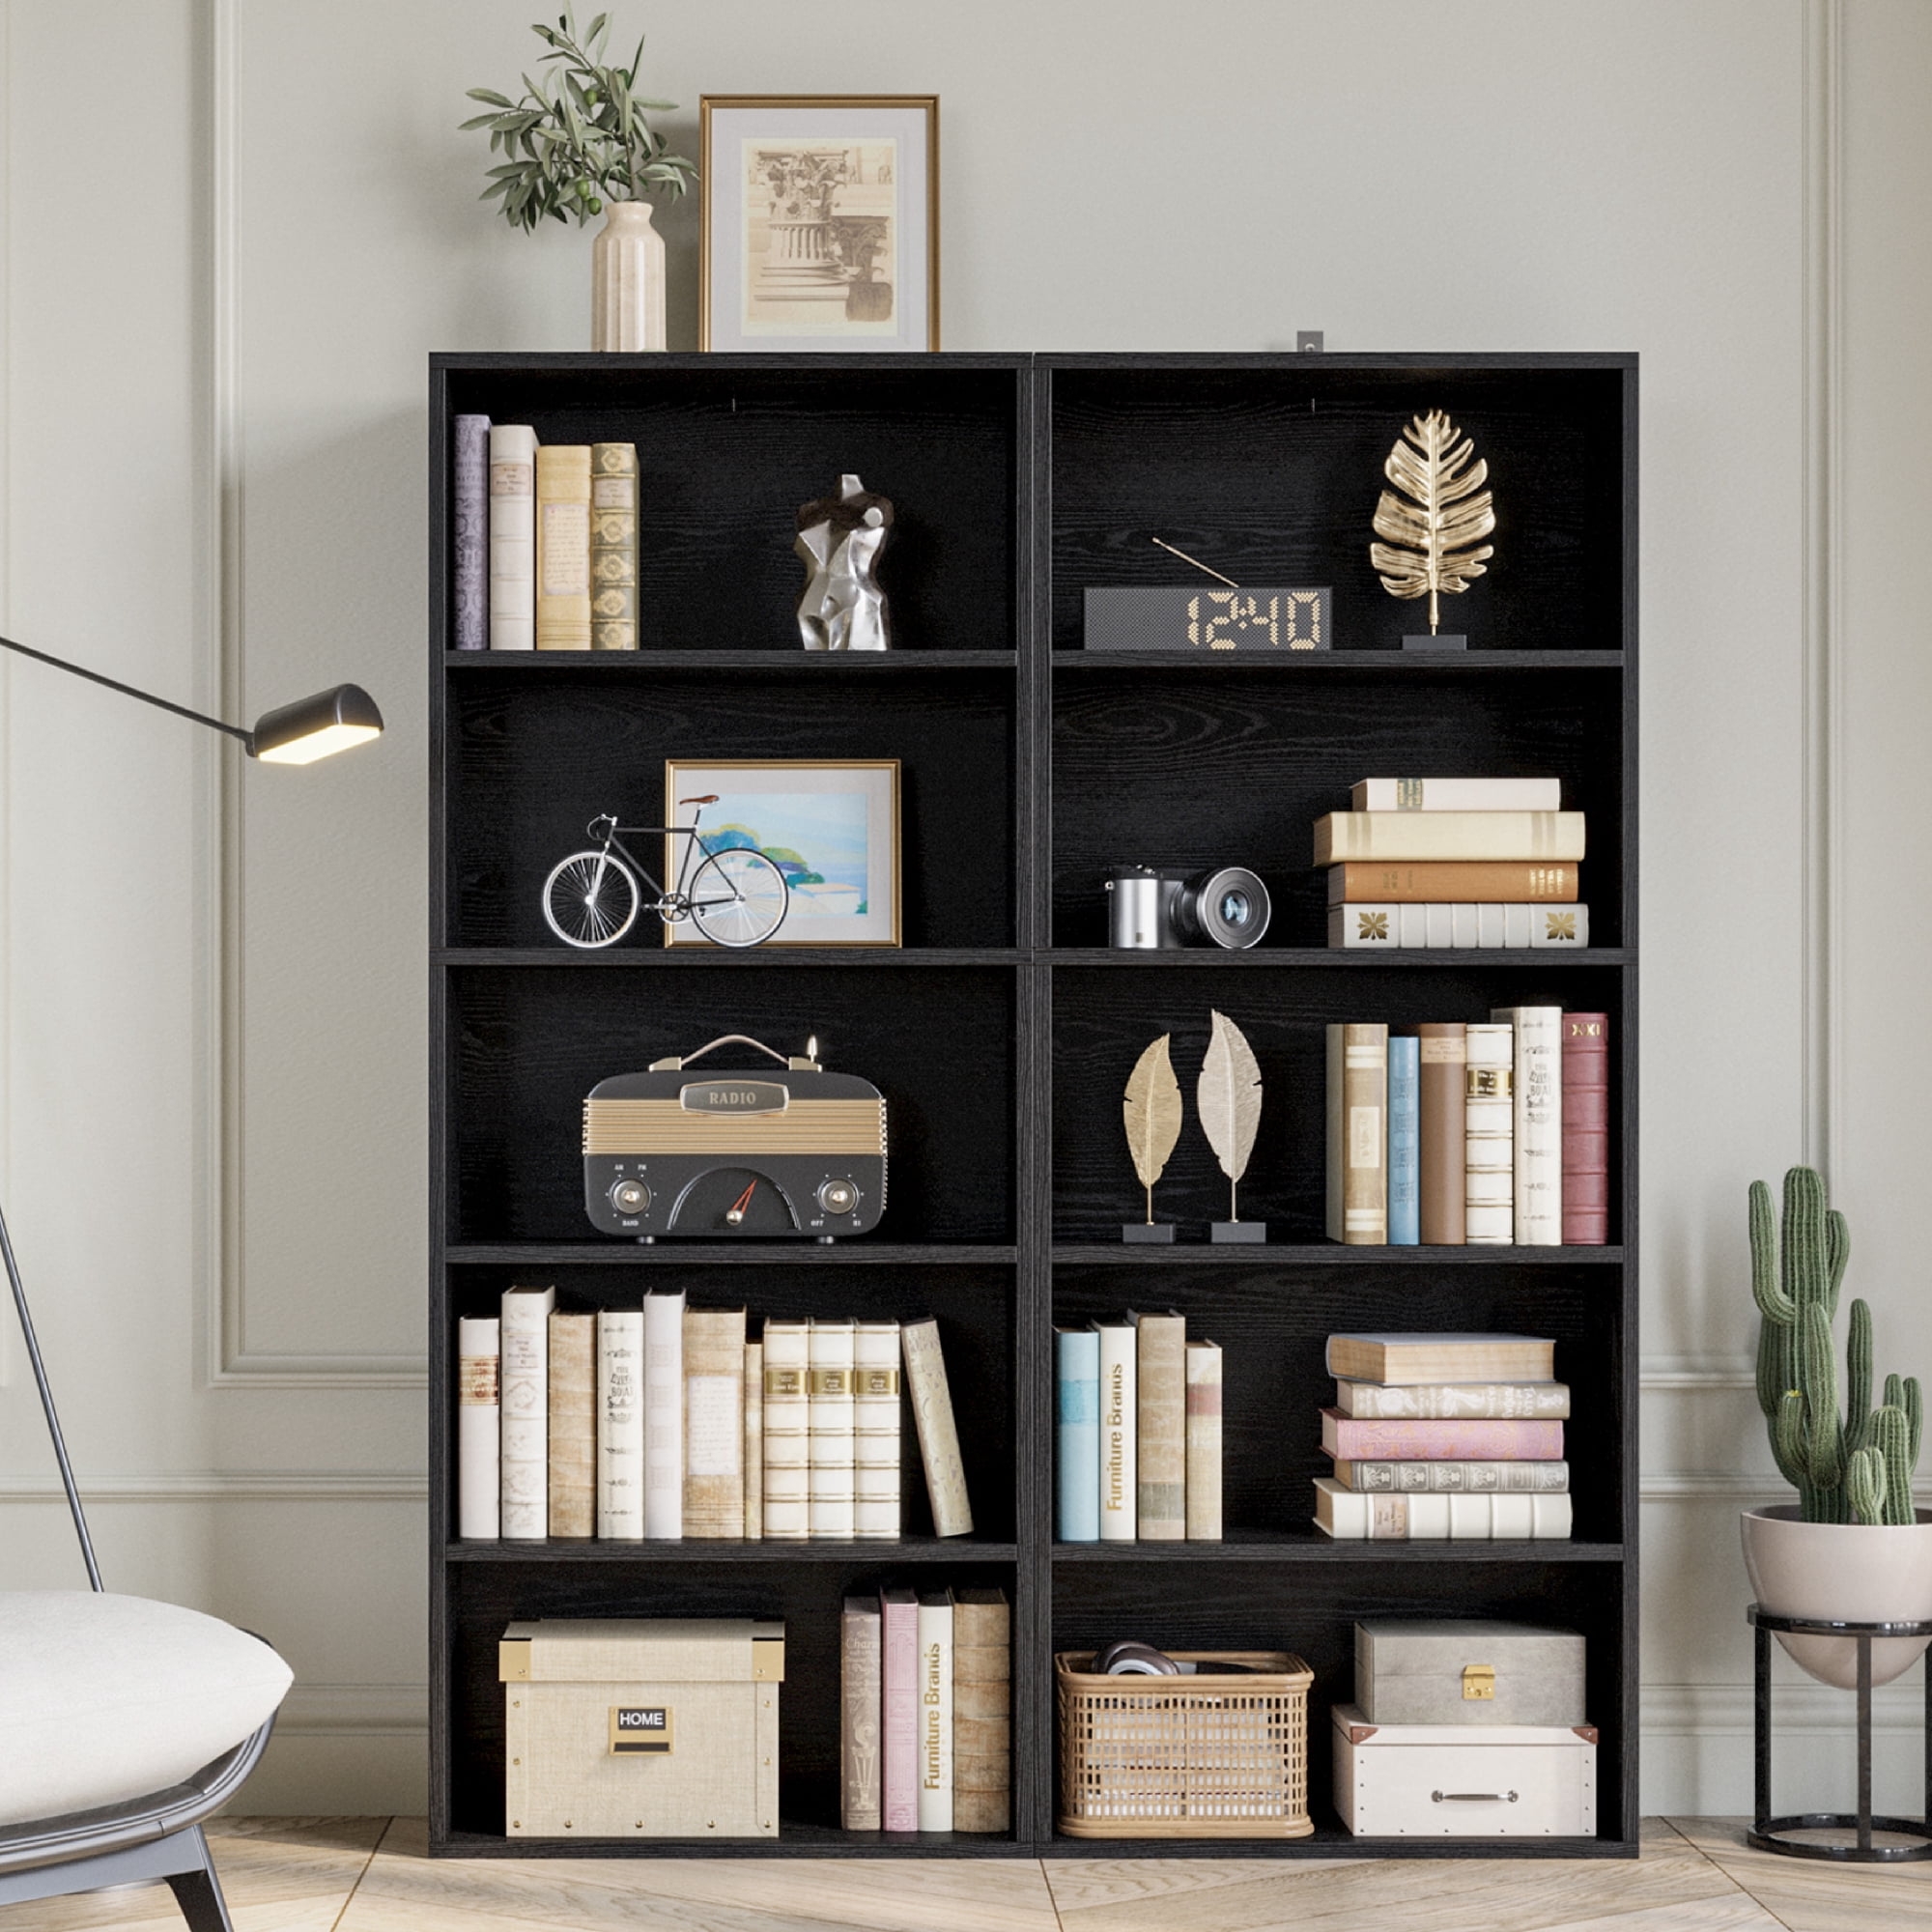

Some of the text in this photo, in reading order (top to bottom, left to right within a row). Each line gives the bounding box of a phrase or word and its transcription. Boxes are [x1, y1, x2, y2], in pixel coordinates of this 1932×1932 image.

[1187, 591, 1321, 650] 12:40
[709, 1092, 756, 1105] RADIO
[1106, 1431, 1123, 1511] Furniture
[619, 1712, 664, 1726] HOME
[923, 1642, 941, 1790] Furniture Brands
